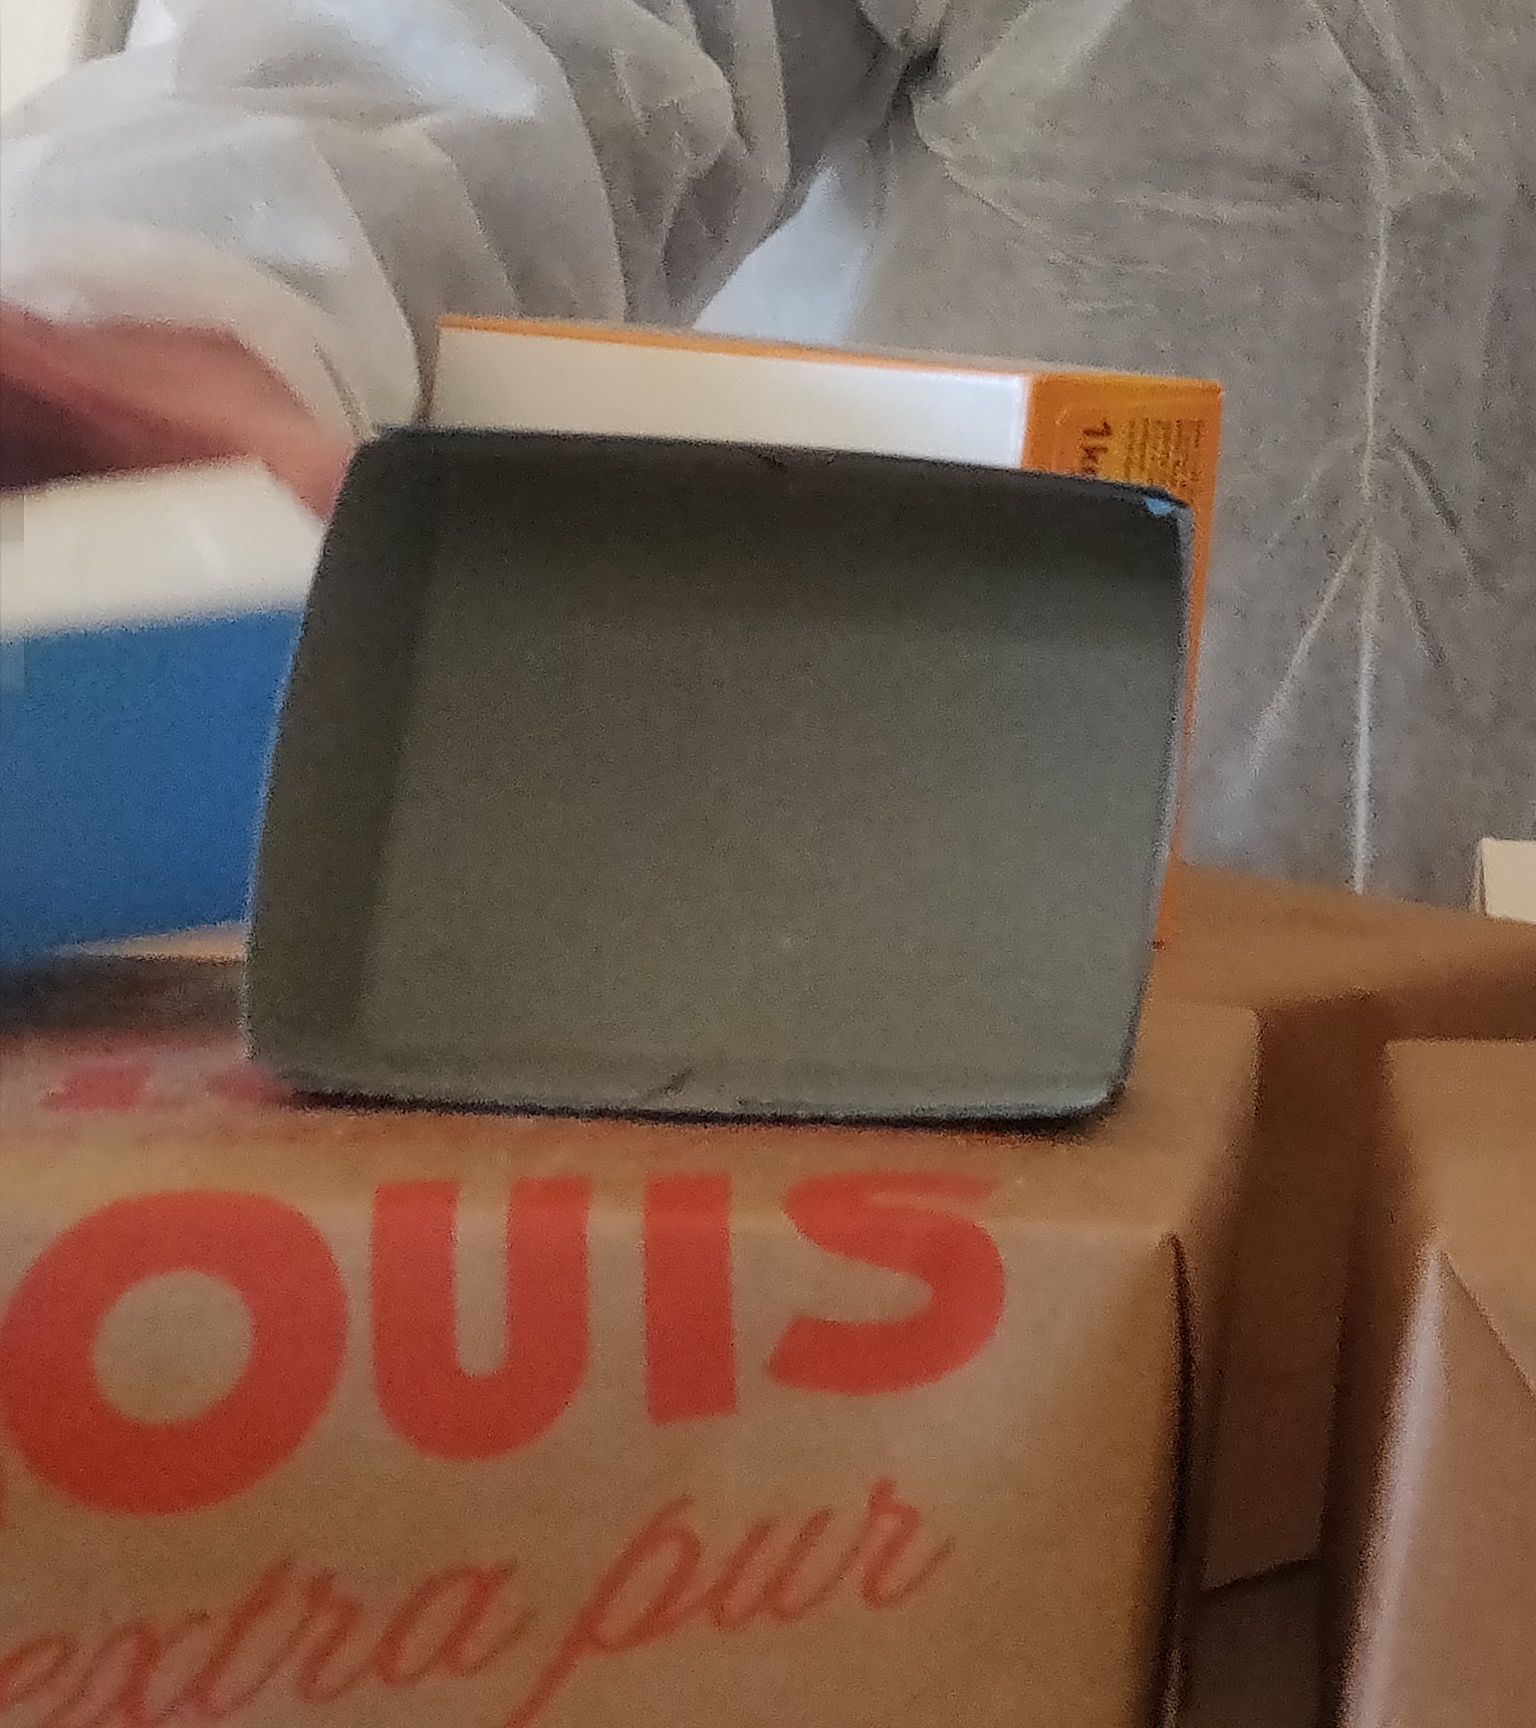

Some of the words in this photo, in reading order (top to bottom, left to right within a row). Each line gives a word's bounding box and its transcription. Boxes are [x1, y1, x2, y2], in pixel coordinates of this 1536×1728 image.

[0, 1170, 1008, 1518] OUIS
[0, 1556, 536, 1728] extra
[500, 1477, 955, 1728] pur
